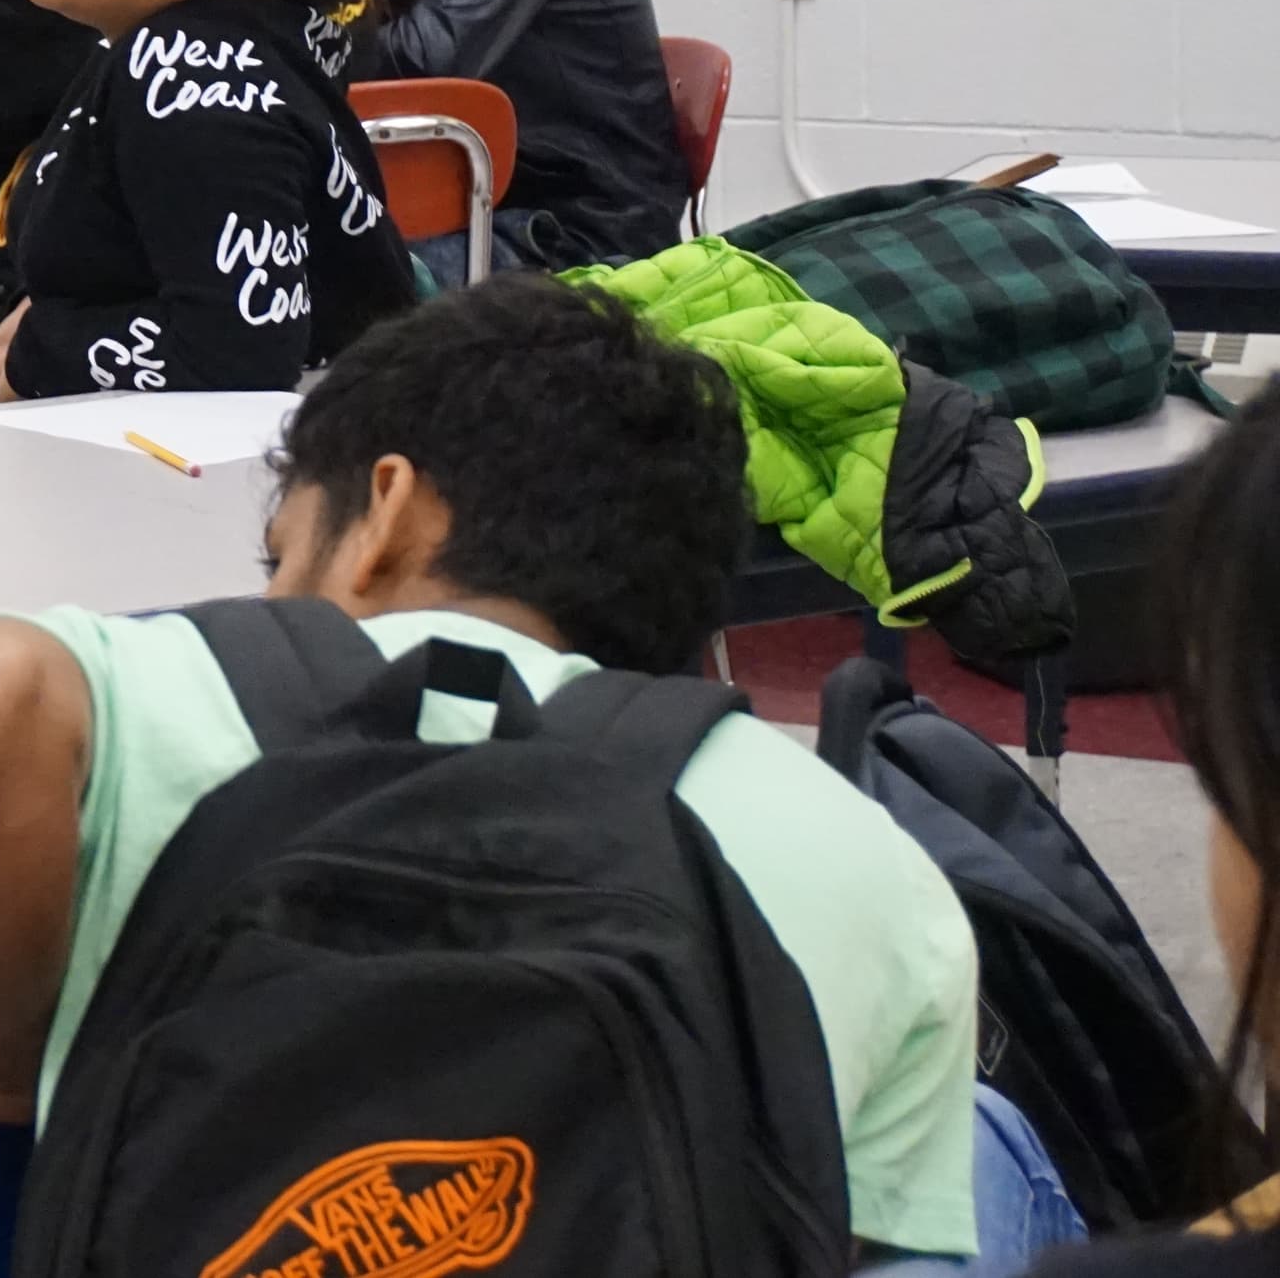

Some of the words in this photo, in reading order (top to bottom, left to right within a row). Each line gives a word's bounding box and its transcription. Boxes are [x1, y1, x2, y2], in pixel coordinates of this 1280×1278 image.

[129, 27, 263, 79] West
[146, 67, 286, 119] Coast
[290, 1165, 397, 1249] VANS
[335, 1210, 417, 1276] THE
